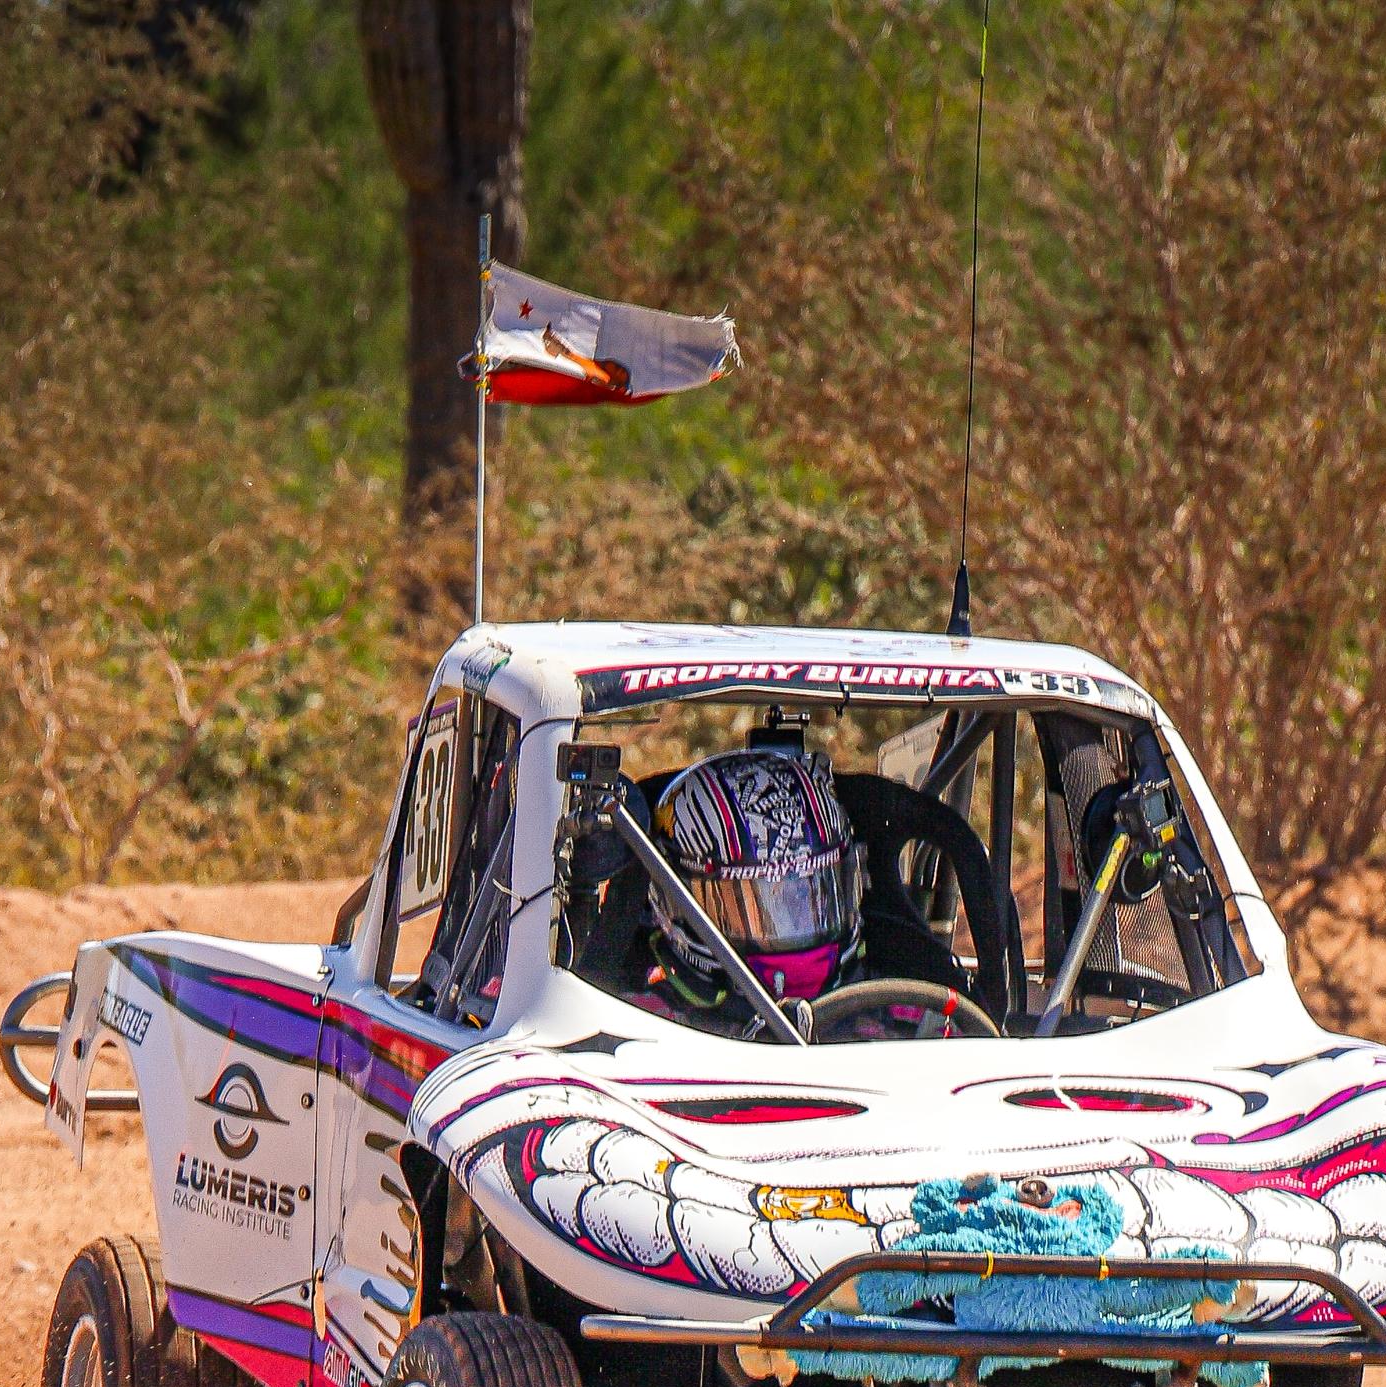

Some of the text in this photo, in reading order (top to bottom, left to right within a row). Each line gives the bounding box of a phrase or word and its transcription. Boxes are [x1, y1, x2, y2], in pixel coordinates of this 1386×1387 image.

[621, 664, 802, 694] TROPHY
[804, 664, 999, 688] BURRITA
[176, 1151, 295, 1217] LUMERIS
[173, 1189, 292, 1240] RACING INSTITUTE
